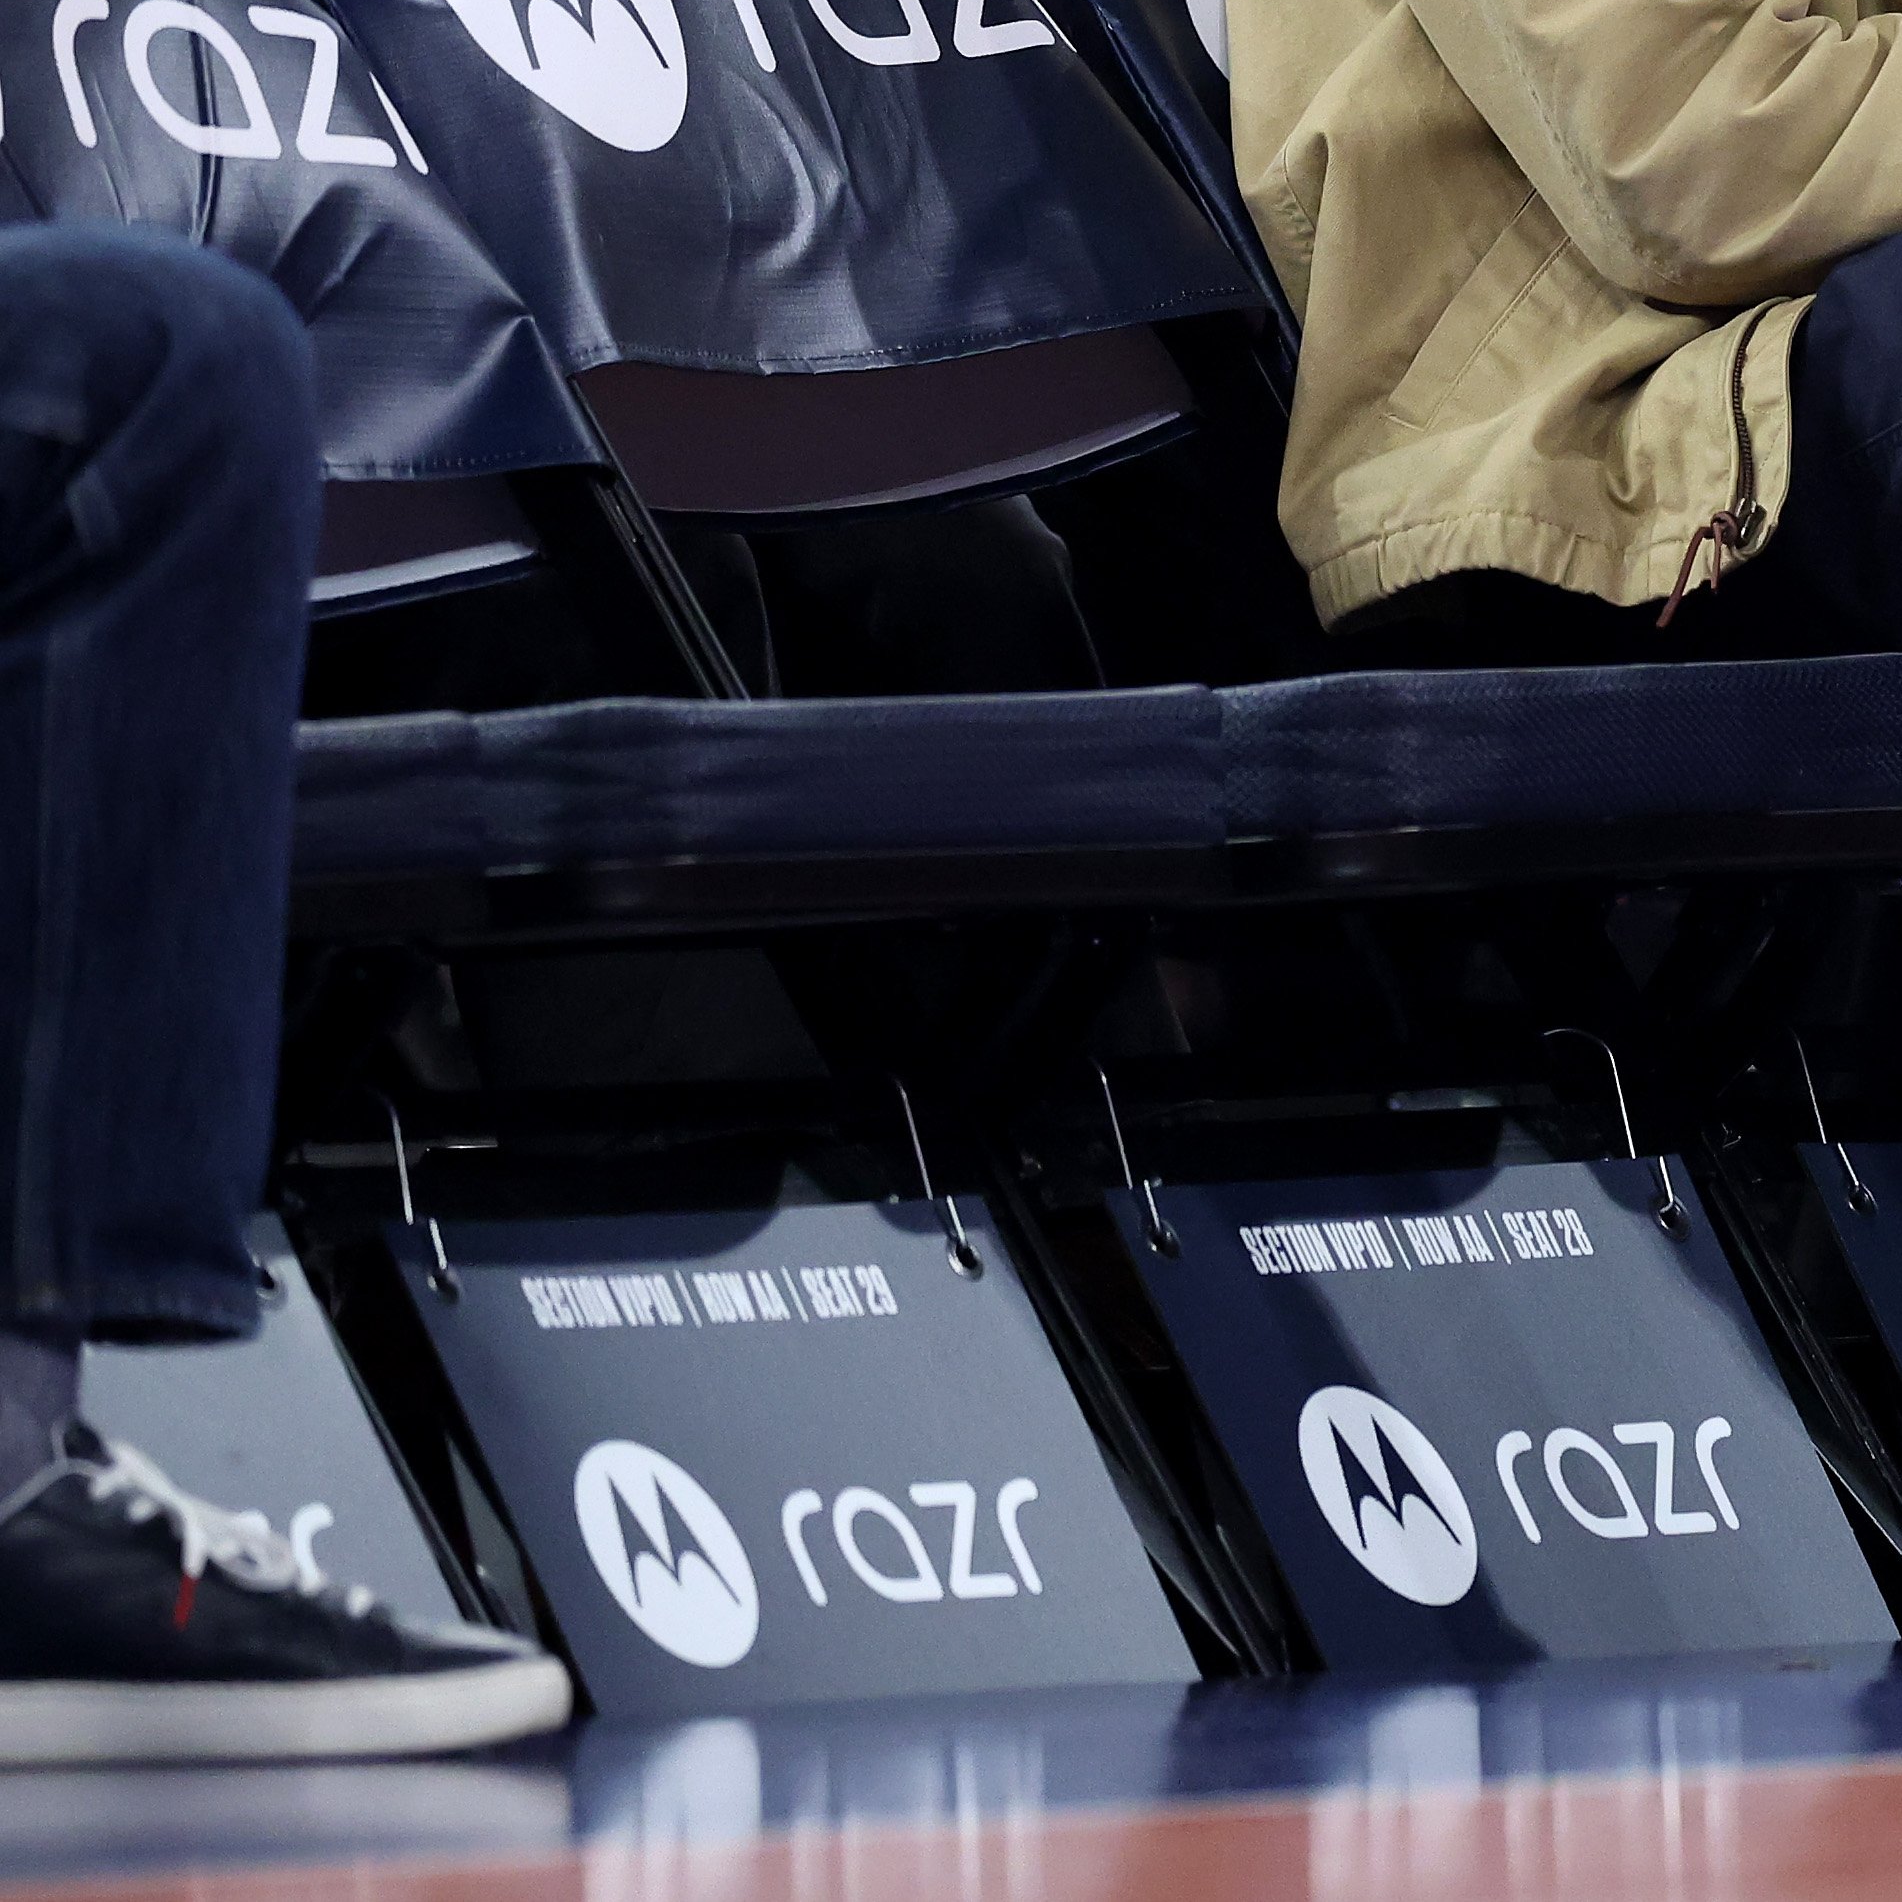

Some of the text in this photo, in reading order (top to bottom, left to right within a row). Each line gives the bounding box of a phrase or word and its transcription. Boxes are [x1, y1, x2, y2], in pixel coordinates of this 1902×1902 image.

[1239, 1222, 1338, 1276] SECTION
[1322, 1219, 1394, 1271] VIP10
[1401, 1216, 1463, 1267] ROW
[1452, 1214, 1495, 1263] AA
[1502, 1210, 1564, 1260] SEAT
[800, 1266, 866, 1320] SEAT
[1495, 1416, 1740, 1544] razr
[781, 1476, 1043, 1608] razr
